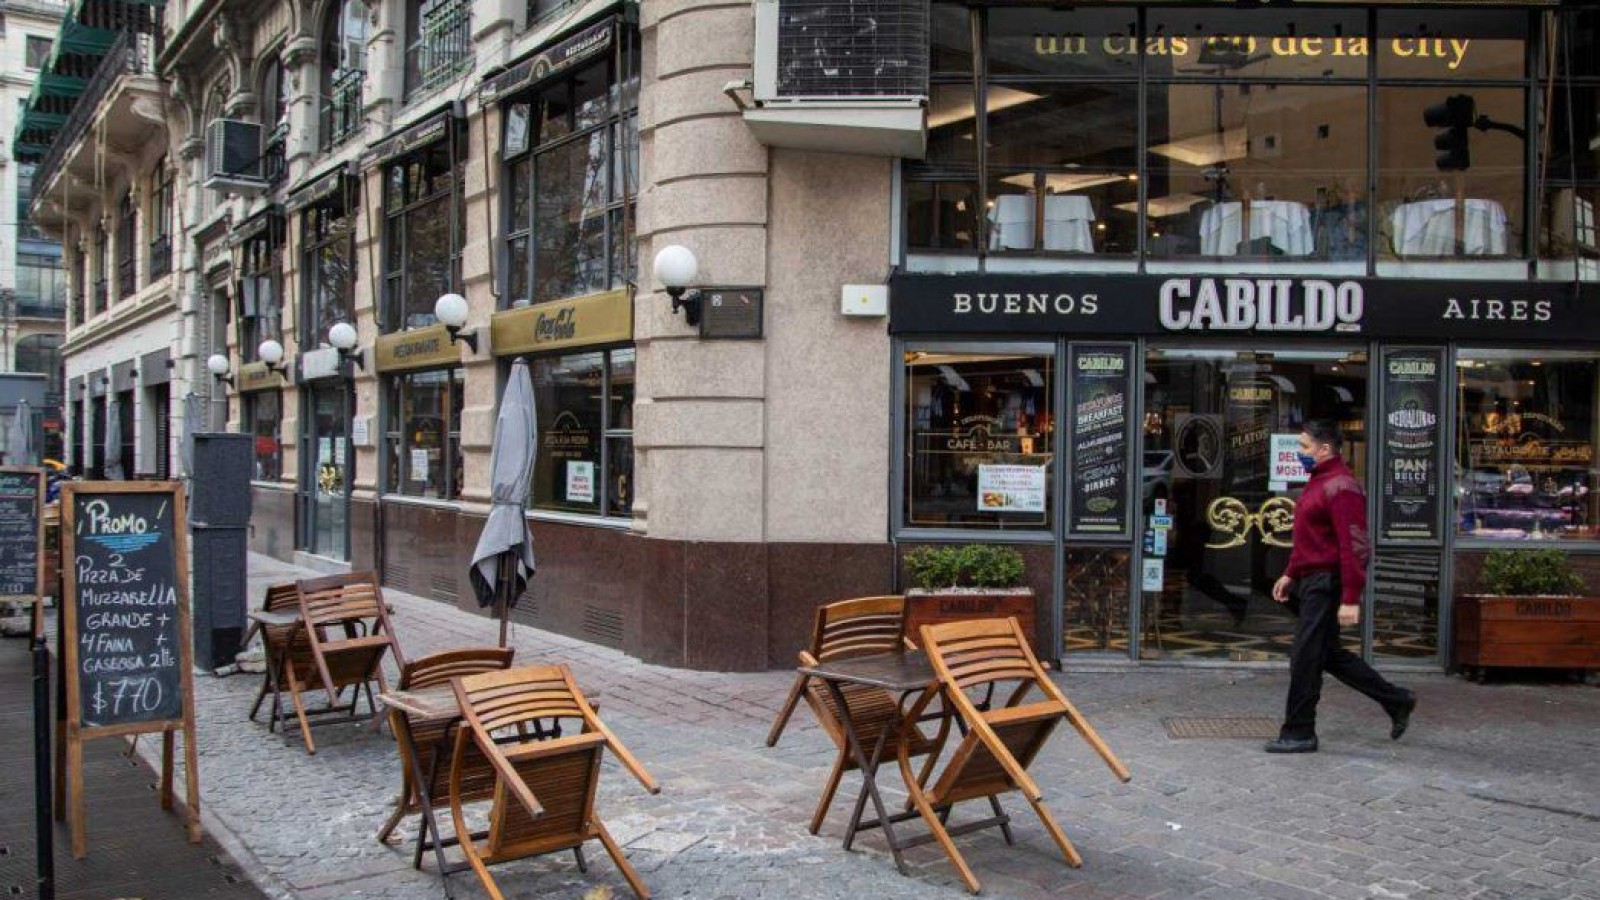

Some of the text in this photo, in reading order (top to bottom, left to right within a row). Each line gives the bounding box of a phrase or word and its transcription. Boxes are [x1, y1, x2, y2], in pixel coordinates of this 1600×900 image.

[1034, 22, 1469, 70] un clásco de la city
[953, 278, 1552, 332] BUENOS CABILDO AIRES
[1394, 458, 1428, 472] PAN
[109, 554, 126, 567] 2
[121, 568, 146, 583] DE
[86, 612, 153, 630] GRANDE
[82, 633, 96, 652] 4
[92, 677, 162, 714] $770
